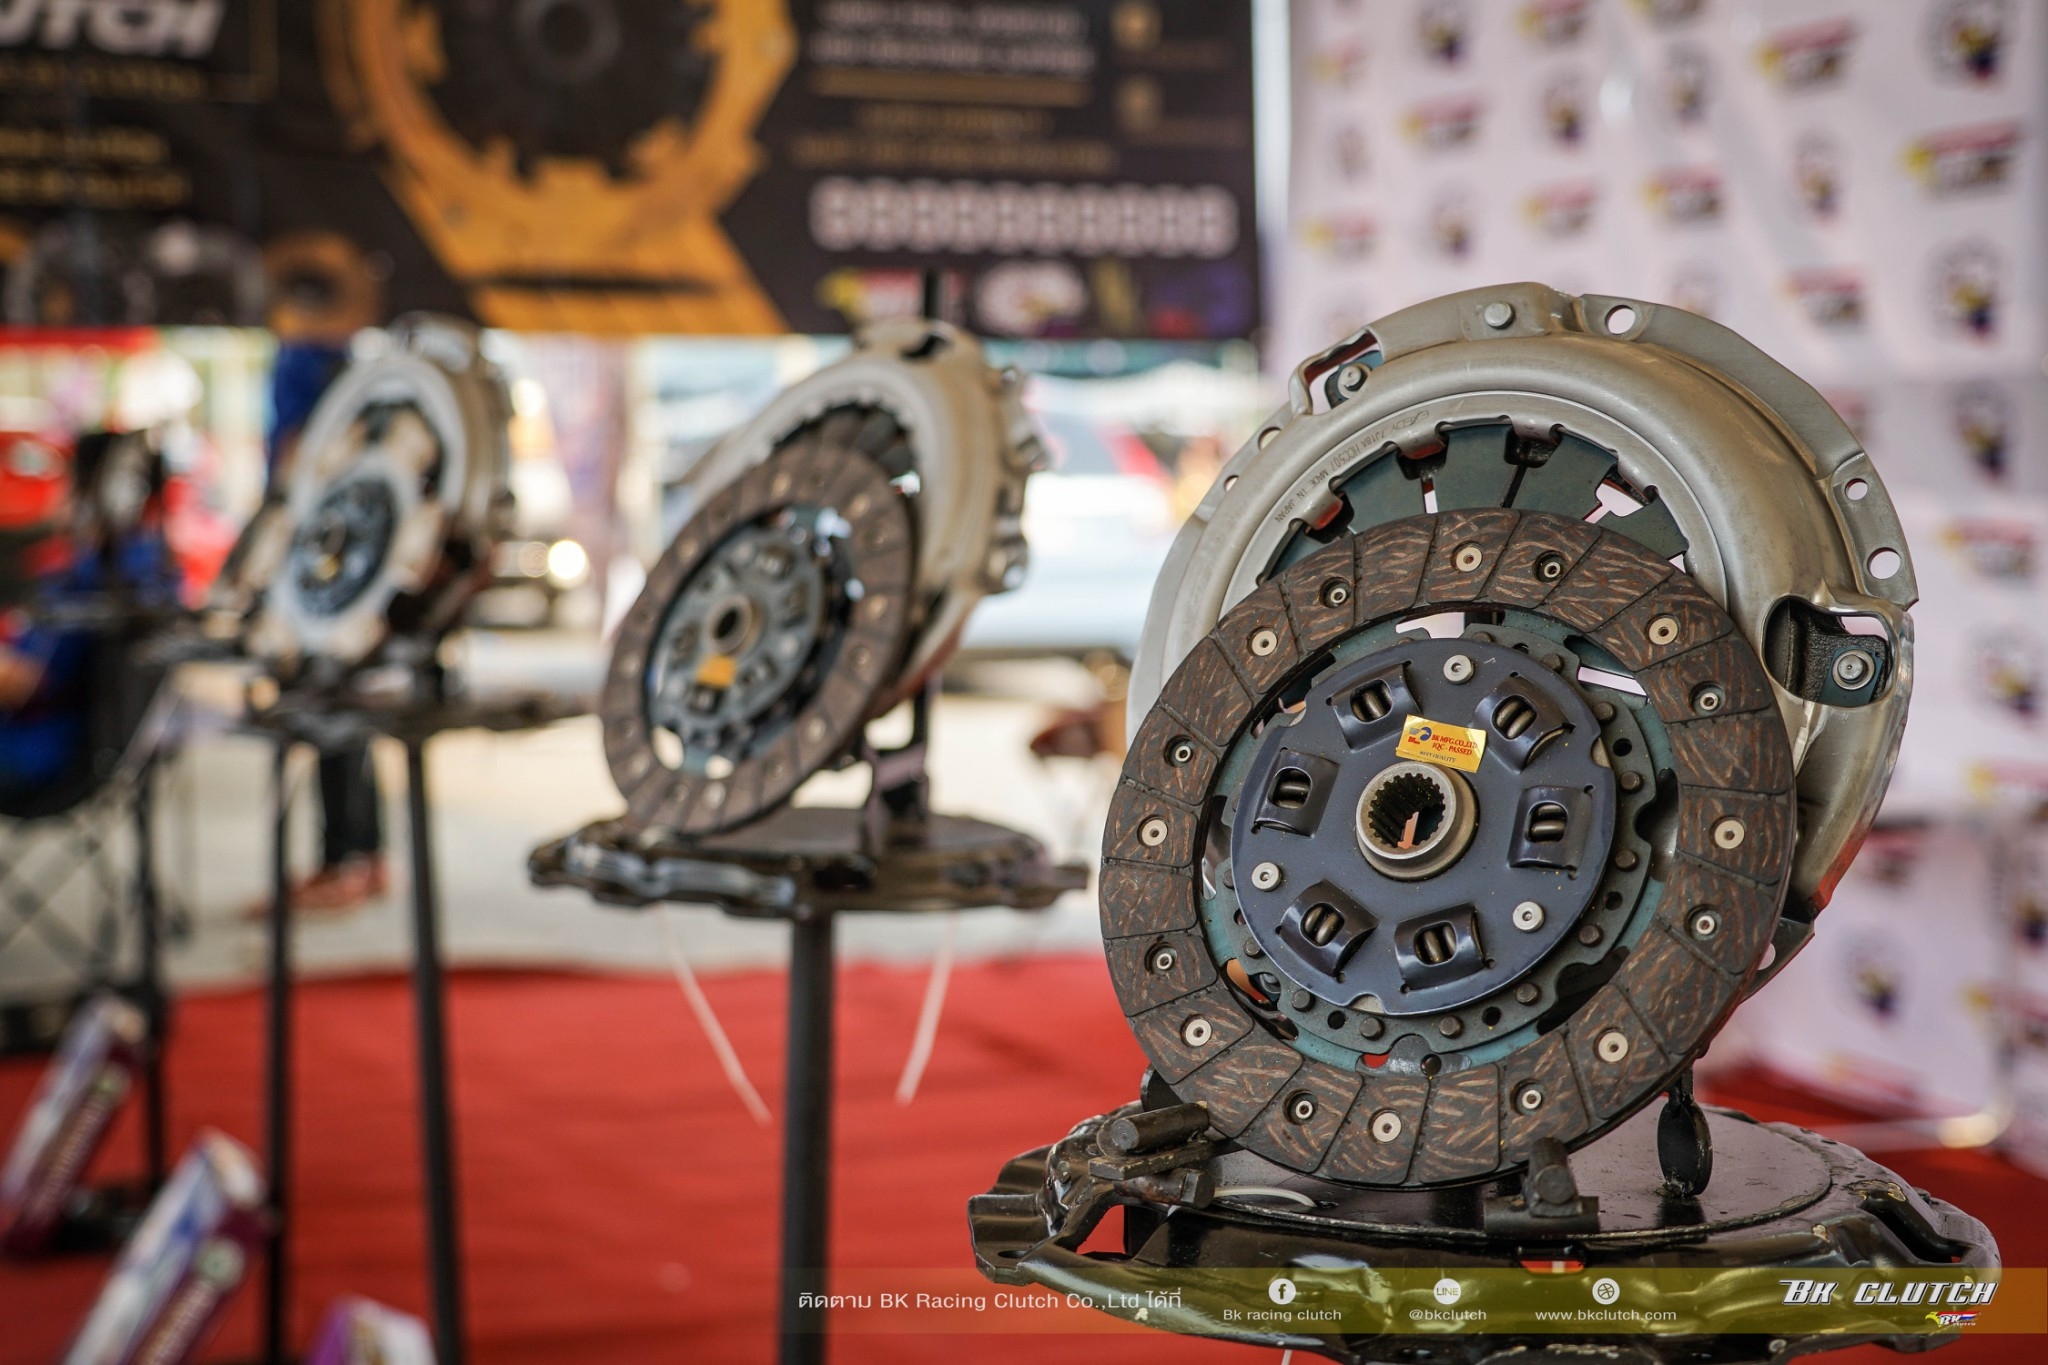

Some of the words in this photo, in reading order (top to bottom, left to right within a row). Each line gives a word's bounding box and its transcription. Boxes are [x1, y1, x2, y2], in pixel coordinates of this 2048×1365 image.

[1390, 410, 1429, 432] EXEDY
[1331, 445, 1360, 470] HCC507
[1311, 469, 1329, 488] MADE
[1296, 489, 1307, 501] IN
[1275, 500, 1295, 523] JAPAN
[1448, 745, 1473, 756] PASSED
